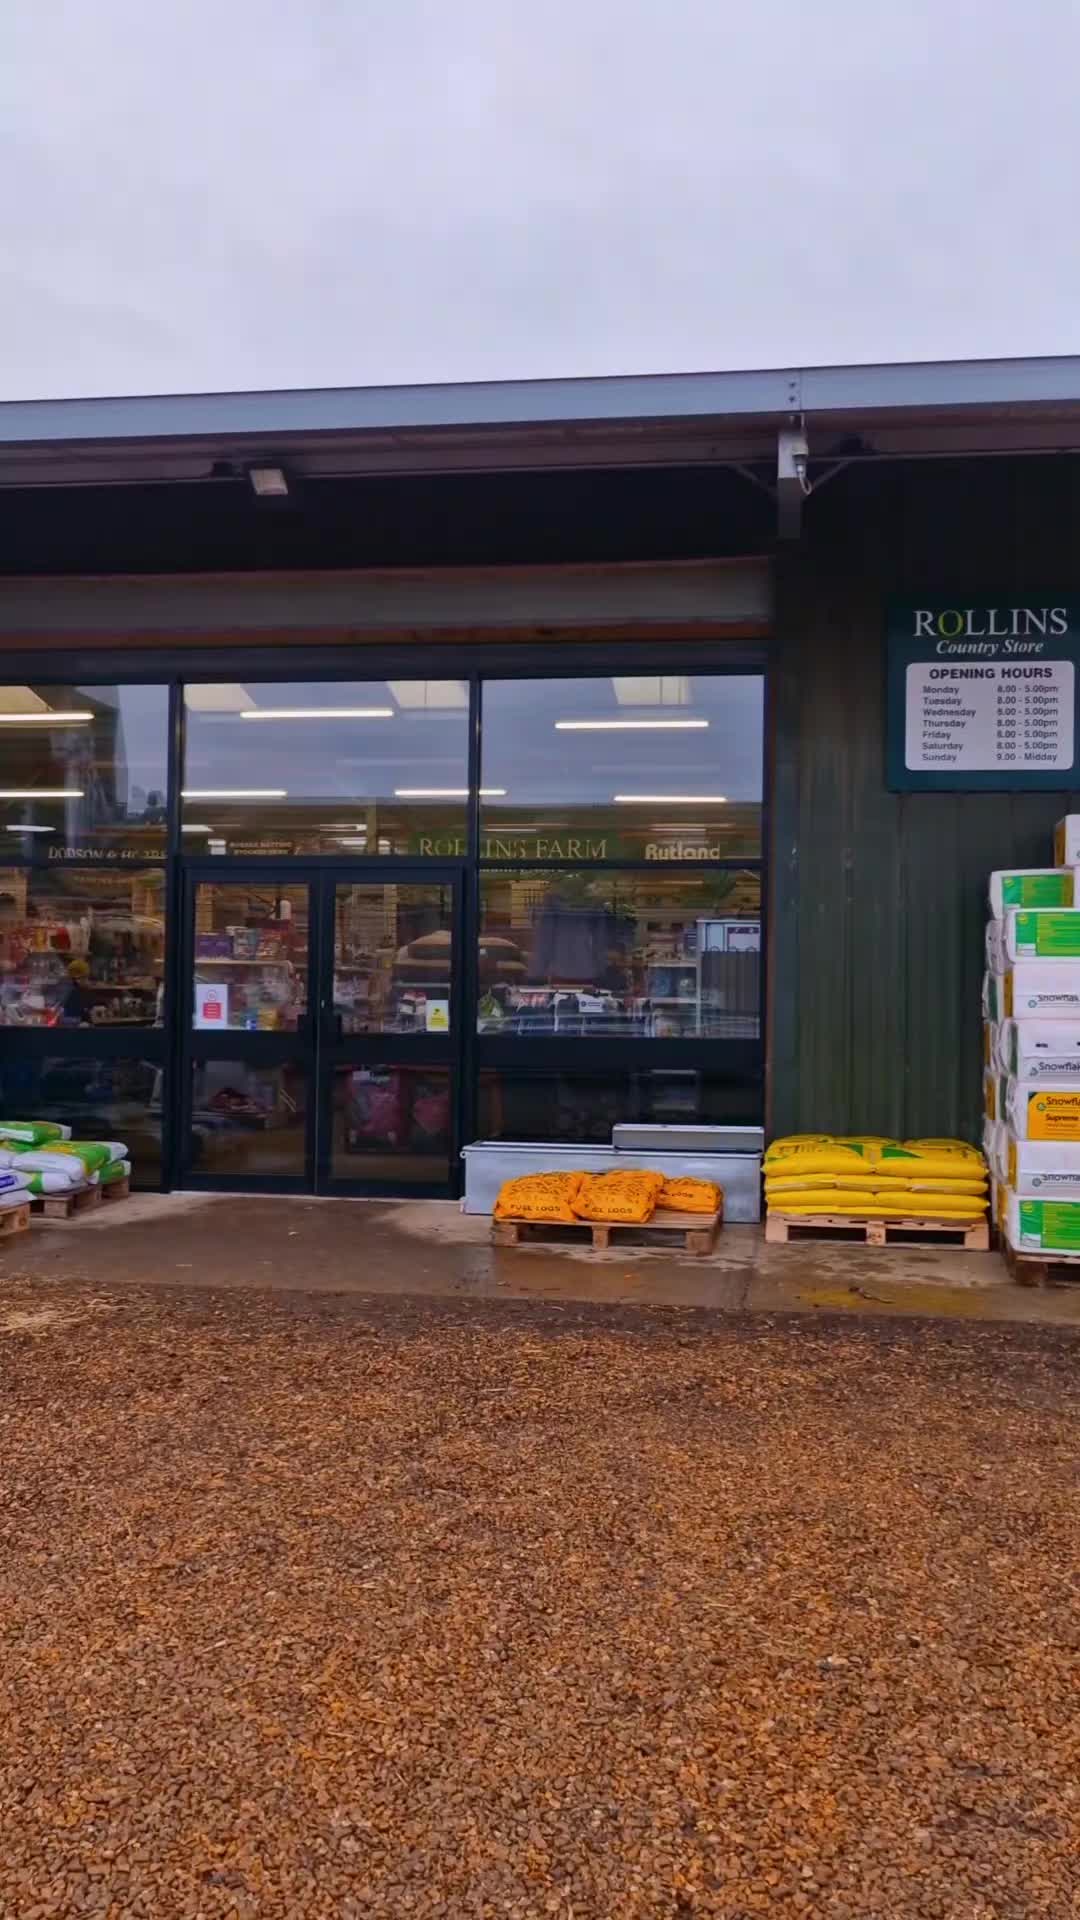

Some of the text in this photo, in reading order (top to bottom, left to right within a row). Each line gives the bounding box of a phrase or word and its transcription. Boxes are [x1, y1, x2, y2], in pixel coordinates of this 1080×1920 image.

[913, 608, 1068, 637] ROLLINS
[936, 639, 1044, 656] Country Store
[929, 667, 1053, 679] OPENING HOURS
[922, 686, 959, 696] Monday
[1024, 685, 1058, 694] 5.00pm
[922, 697, 962, 707] Tuesday
[1024, 696, 1058, 705] 5.00pm
[922, 708, 976, 717] Wednesday
[1024, 708, 1058, 717] 5.00pm
[922, 719, 966, 728] Thursday
[1024, 719, 1058, 728] 5.00pm
[922, 730, 951, 739] Friday
[1024, 731, 1058, 740] 5.00pm
[922, 742, 964, 751] Saturday
[1024, 742, 1058, 751] 5.00pm
[922, 753, 957, 762] Sunday
[997, 753, 1016, 761] 9.00
[1024, 753, 1057, 762] Midday
[420, 838, 607, 859] ROLINS FARM
[645, 841, 720, 860] Rutland
